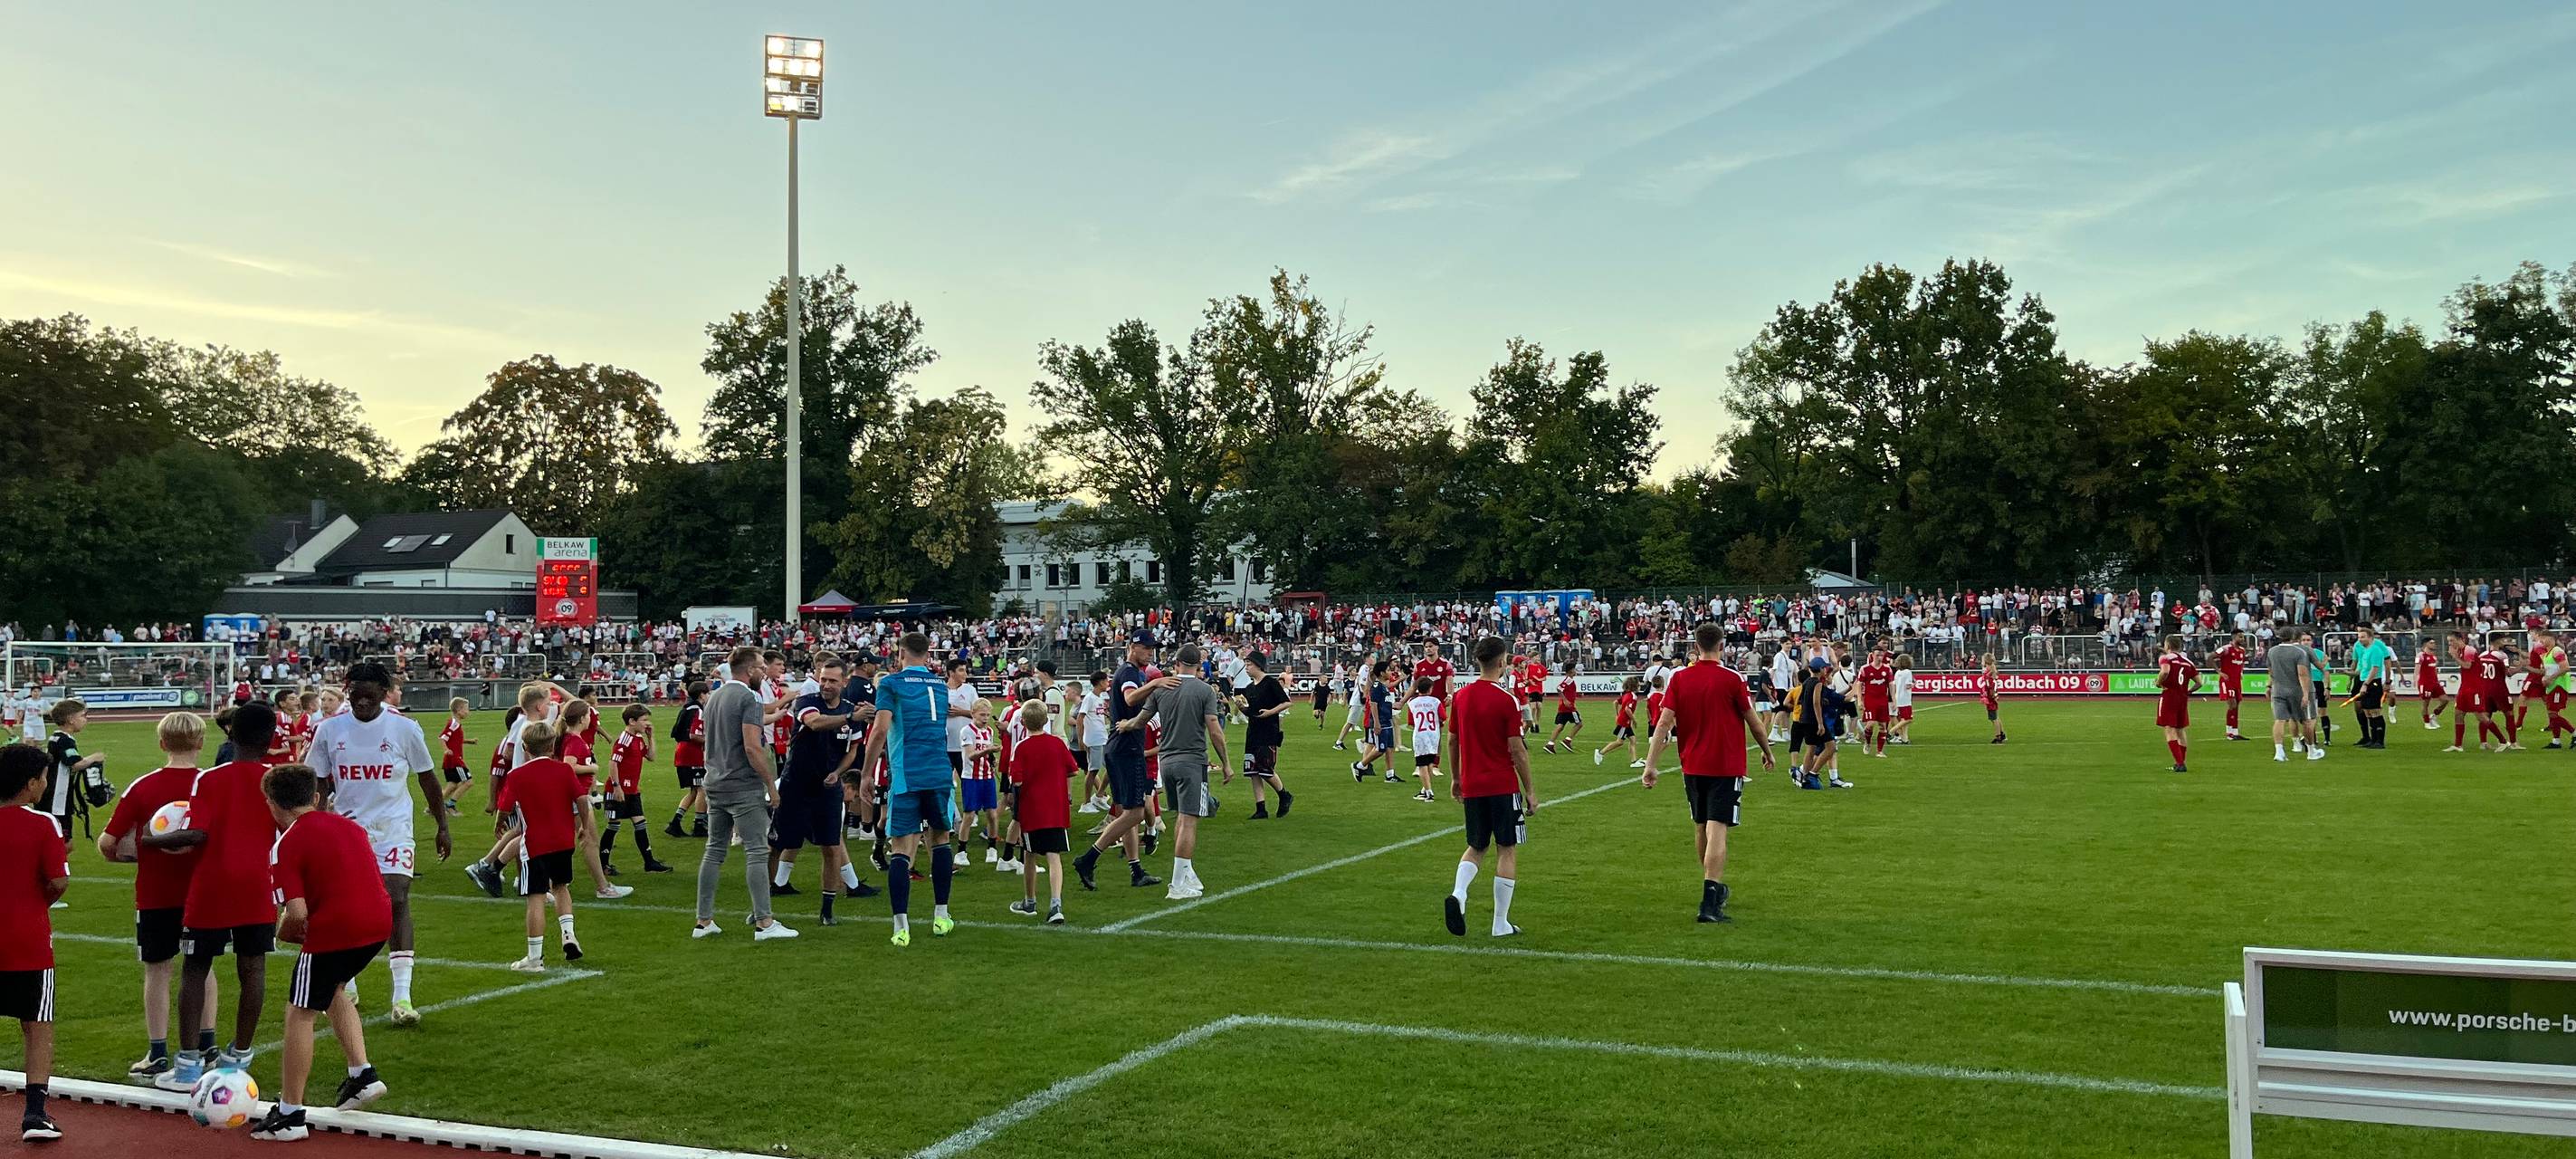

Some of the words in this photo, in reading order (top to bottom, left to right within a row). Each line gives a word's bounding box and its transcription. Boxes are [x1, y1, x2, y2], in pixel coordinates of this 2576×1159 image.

[547, 541, 585, 549] BELKAW
[554, 549, 587, 557] arena
[561, 604, 573, 613] 09
[1912, 675, 1973, 693] ergisch
[1977, 675, 2055, 689] Gadbach
[2058, 676, 2080, 689] 09
[2178, 666, 2185, 685] 6
[1580, 683, 1617, 692] BELKAW
[927, 685, 937, 722] 1
[1416, 711, 1436, 733] 29
[1865, 712, 1873, 720] 11
[339, 764, 394, 781] REWE
[384, 847, 414, 870] 43
[2388, 1010, 2576, 1033] www.porsche-b
